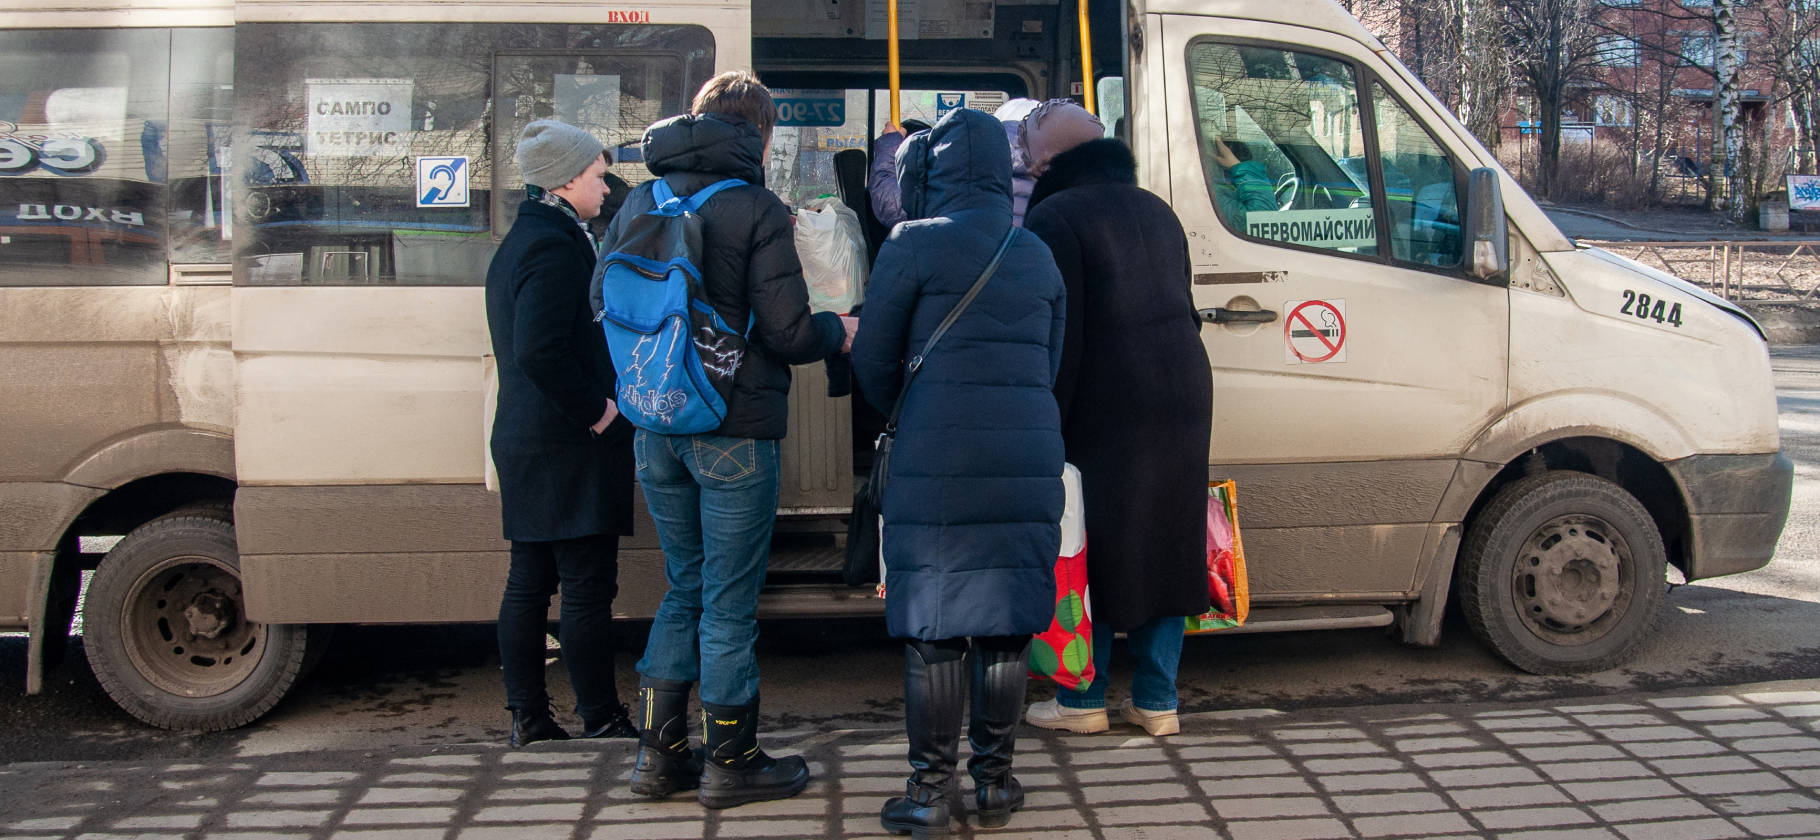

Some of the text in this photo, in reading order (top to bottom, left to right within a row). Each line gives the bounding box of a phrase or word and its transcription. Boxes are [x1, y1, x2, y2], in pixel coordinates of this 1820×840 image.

[607, 11, 650, 24] ВХОД
[316, 101, 391, 116] САМПО
[316, 130, 397, 146] ТЕТРИС
[1250, 215, 1375, 242] ПЕРВОМАЙСКИЙ
[1620, 289, 1683, 327] 2844
